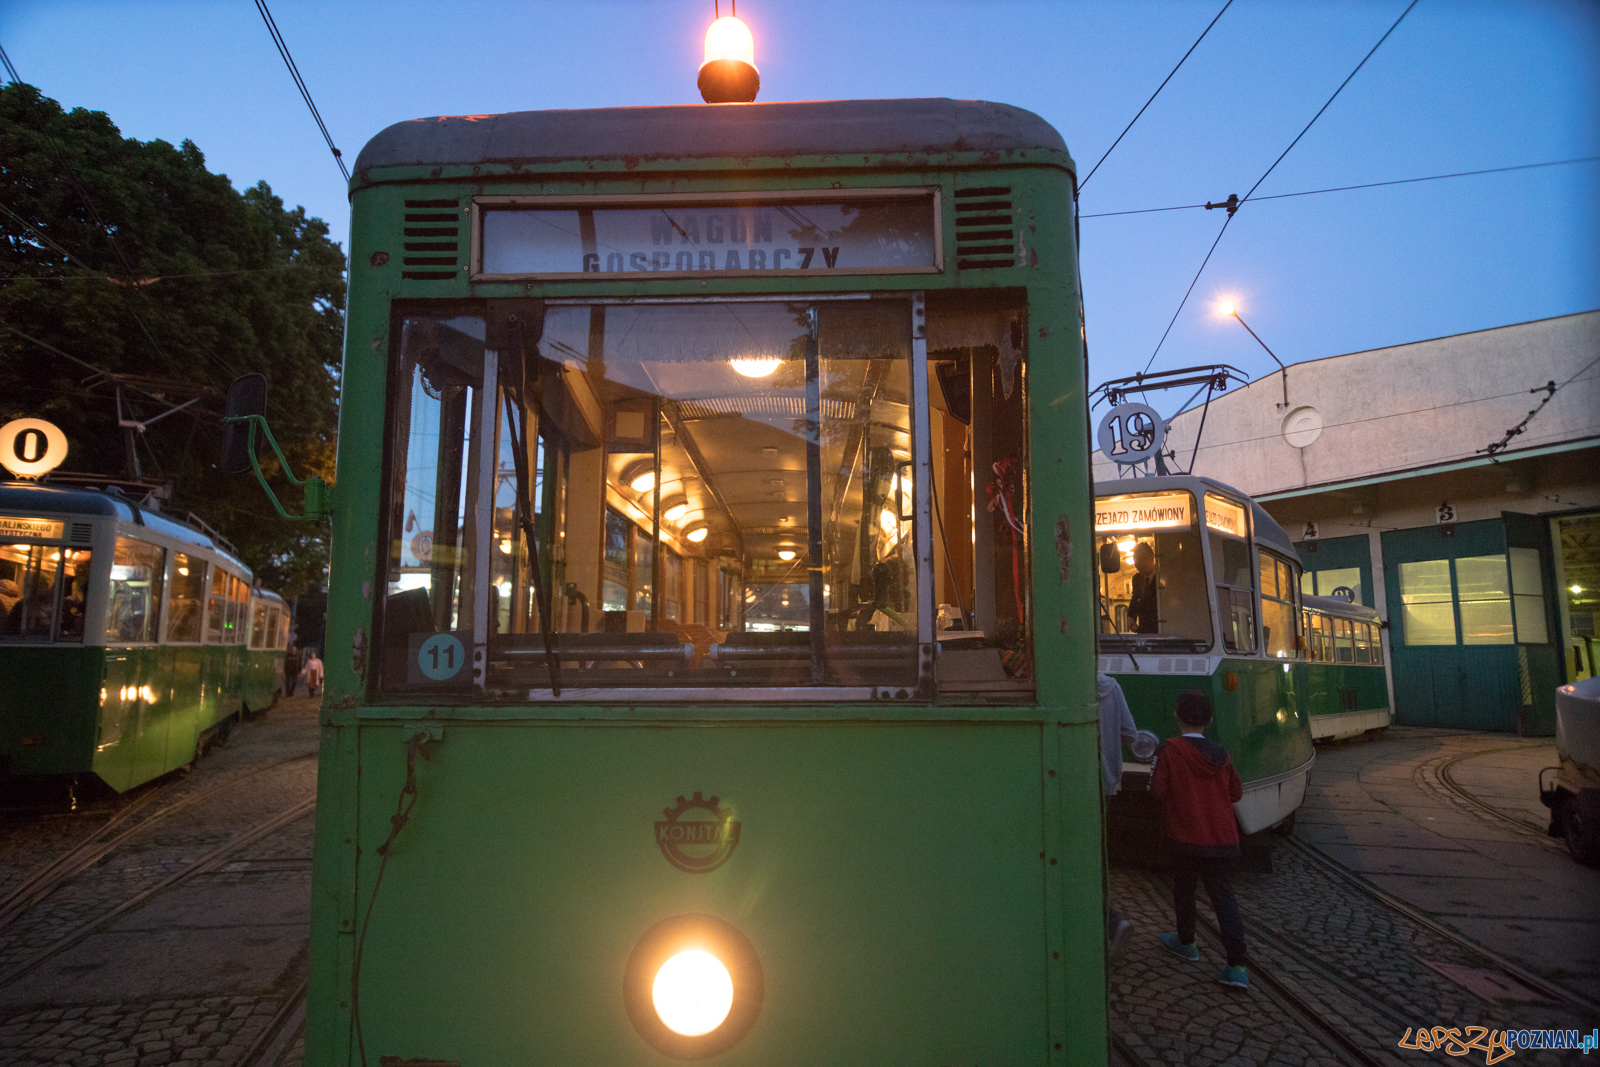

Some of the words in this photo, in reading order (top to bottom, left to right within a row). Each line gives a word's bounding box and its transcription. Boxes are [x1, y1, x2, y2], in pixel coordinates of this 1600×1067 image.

[650, 213, 773, 245] WAGON
[582, 246, 840, 273] GOSPODARCZY
[1108, 412, 1155, 455] 19
[1132, 506, 1185, 524] ZAMÓWIONY
[1438, 506, 1454, 521] 3
[1304, 523, 1317, 538] 4
[426, 645, 455, 670] 11
[659, 825, 735, 841] KONSTAL
